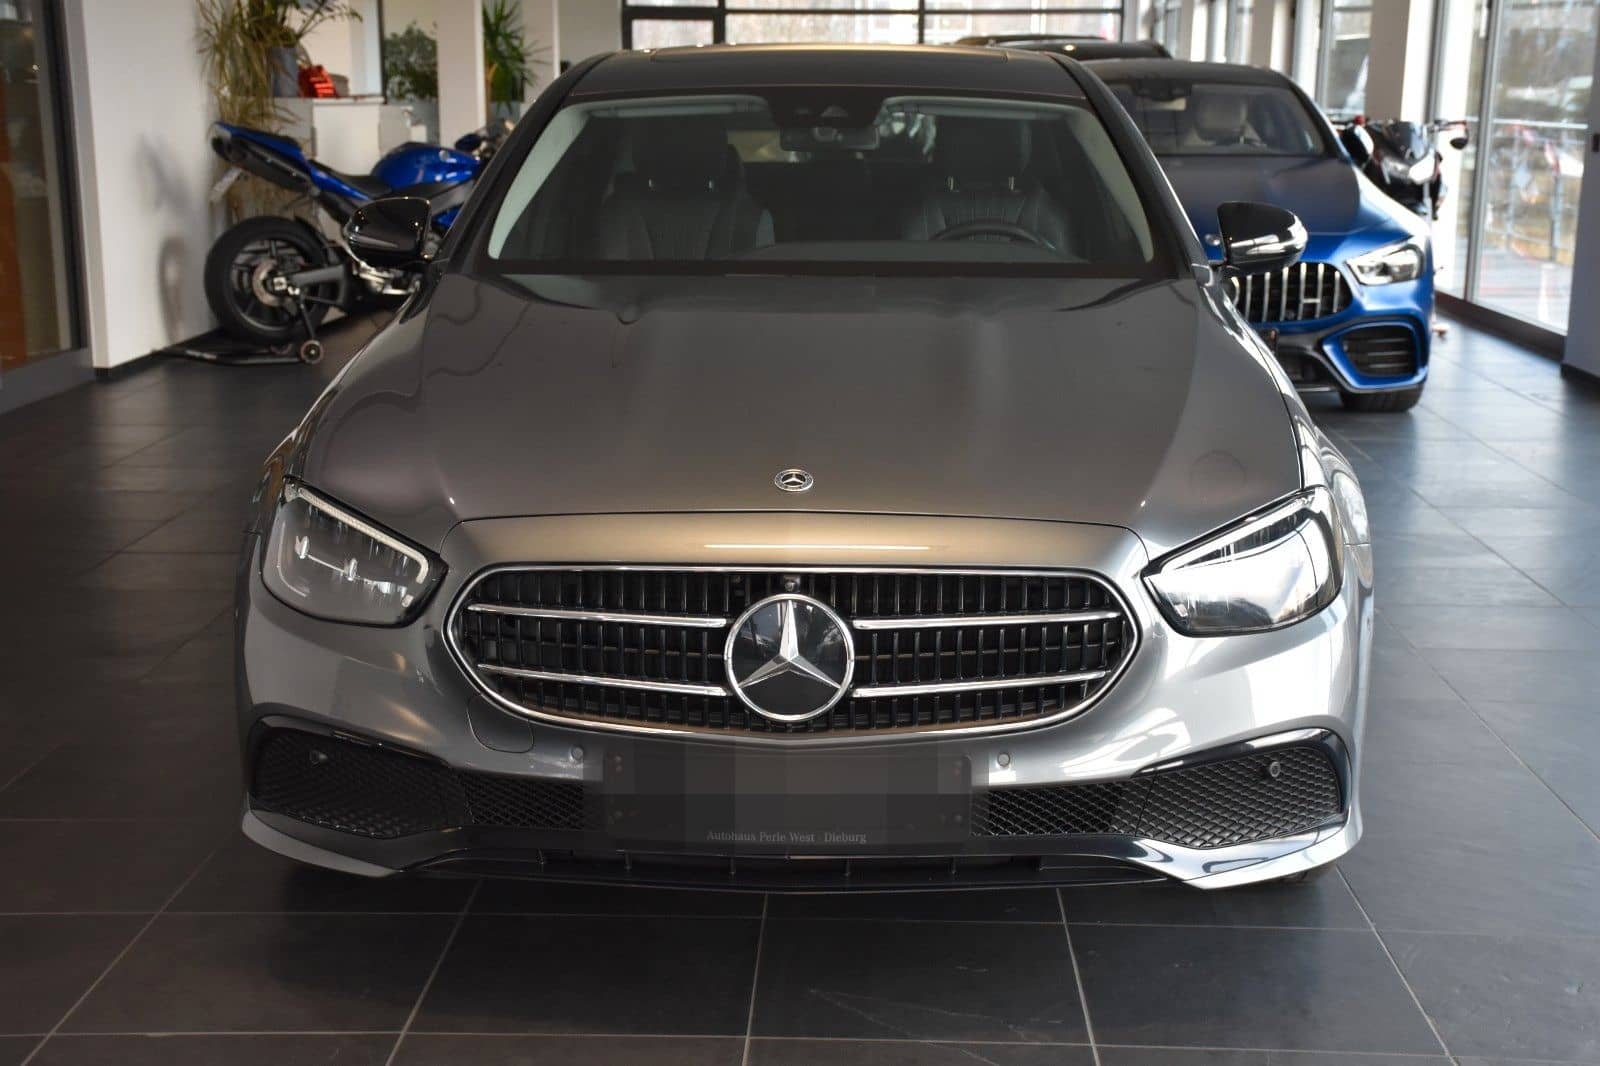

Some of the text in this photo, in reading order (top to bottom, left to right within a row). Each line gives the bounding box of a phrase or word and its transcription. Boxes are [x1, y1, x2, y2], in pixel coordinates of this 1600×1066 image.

[706, 830, 868, 845] Autohaus Perle West Dieburg
